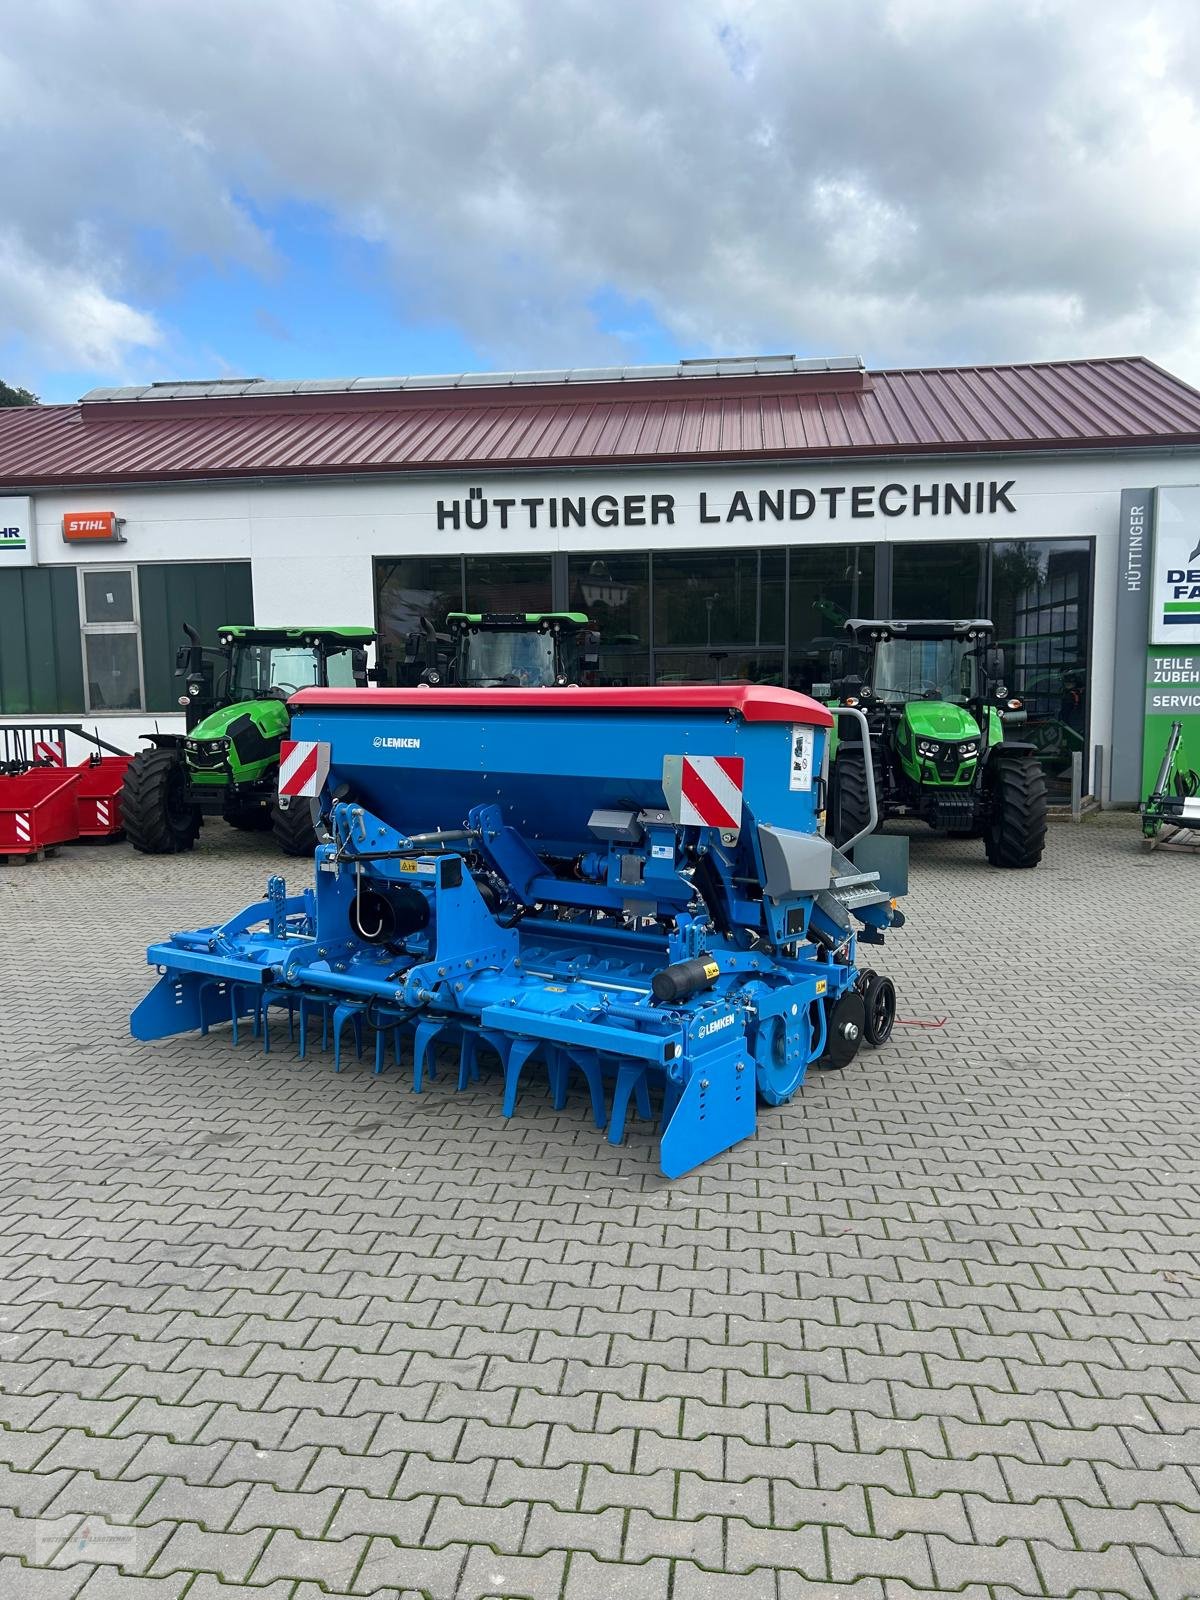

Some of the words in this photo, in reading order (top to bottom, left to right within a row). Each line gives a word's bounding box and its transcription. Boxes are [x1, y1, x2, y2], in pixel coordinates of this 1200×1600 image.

[437, 488, 675, 530] HÜTTINGER
[699, 480, 1017, 524] LANDTECHNIK
[69, 520, 107, 531] STIHL
[1124, 505, 1144, 591] HÜTTINGER
[1154, 658, 1193, 669] TEILE
[1153, 671, 1200, 682] ZUBEH
[1152, 695, 1200, 707] SERVIC
[382, 738, 420, 749] LEMKEN
[706, 1013, 735, 1035] LEMKEN
